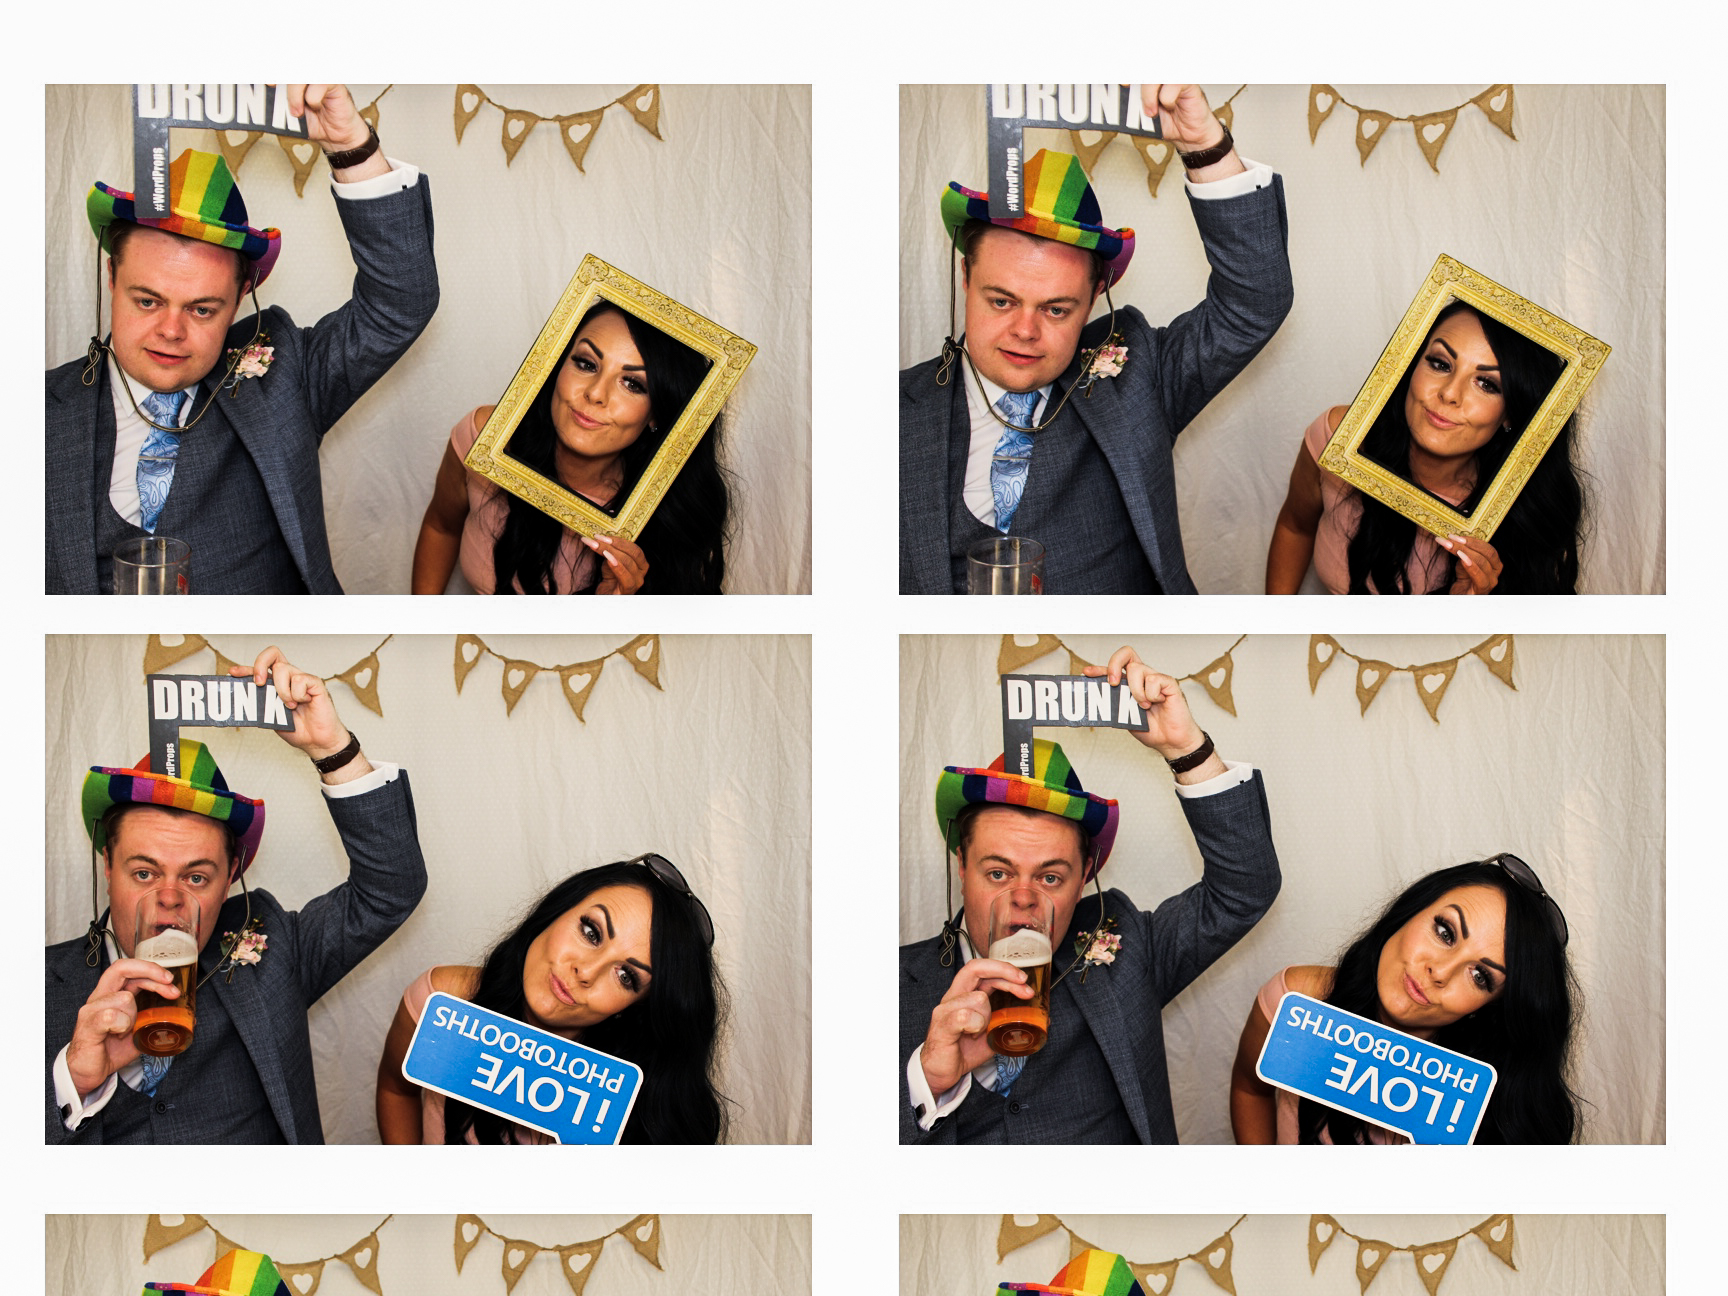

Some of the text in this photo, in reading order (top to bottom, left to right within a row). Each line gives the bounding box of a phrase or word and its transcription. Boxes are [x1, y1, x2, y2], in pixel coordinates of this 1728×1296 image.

[152, 147, 165, 212] #WordProps
[1006, 147, 1019, 212] #WordProps
[153, 679, 288, 726] DRUNK
[1007, 679, 1142, 726] DRUNK
[165, 742, 176, 778] rdProps
[1019, 742, 1030, 778] rdProps
[432, 1006, 625, 1094] PHOTOBOOTHS
[1286, 1006, 1479, 1094] PHOTOBOOTHS
